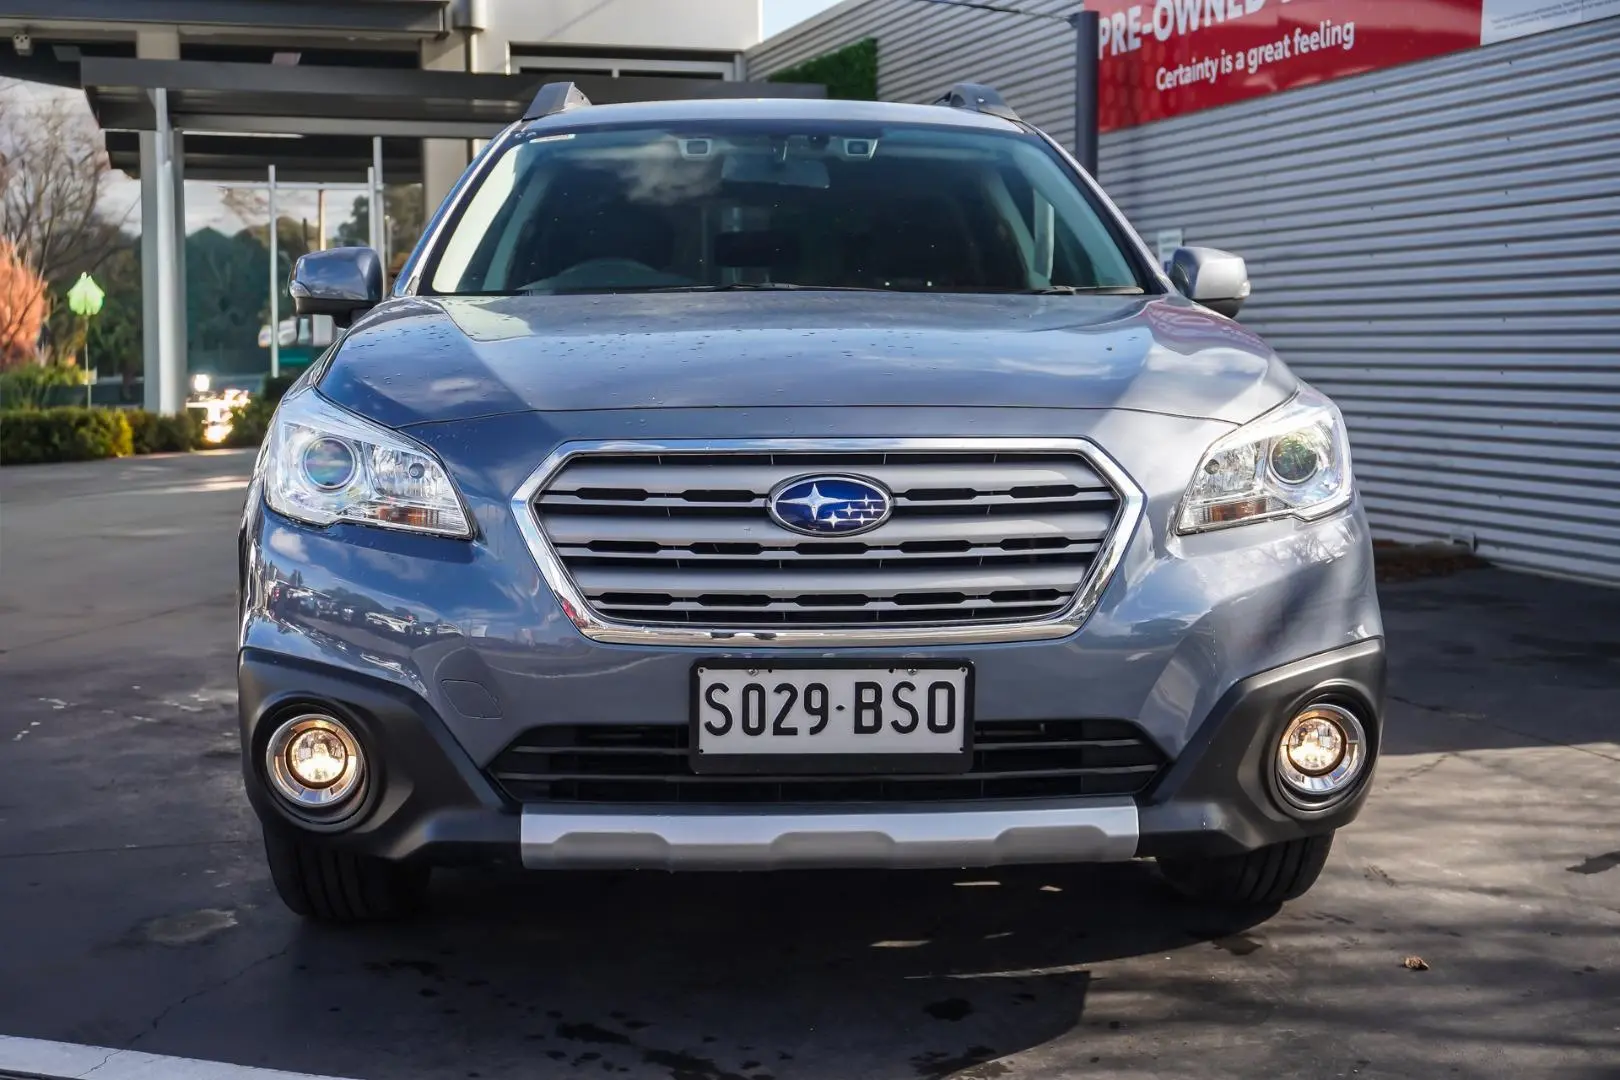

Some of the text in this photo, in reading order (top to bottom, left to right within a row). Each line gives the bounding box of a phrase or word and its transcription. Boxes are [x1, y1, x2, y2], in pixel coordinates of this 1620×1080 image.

[1098, 0, 1265, 59] PRE-OWN
[1156, 20, 1355, 91] Certainty is a great feeling
